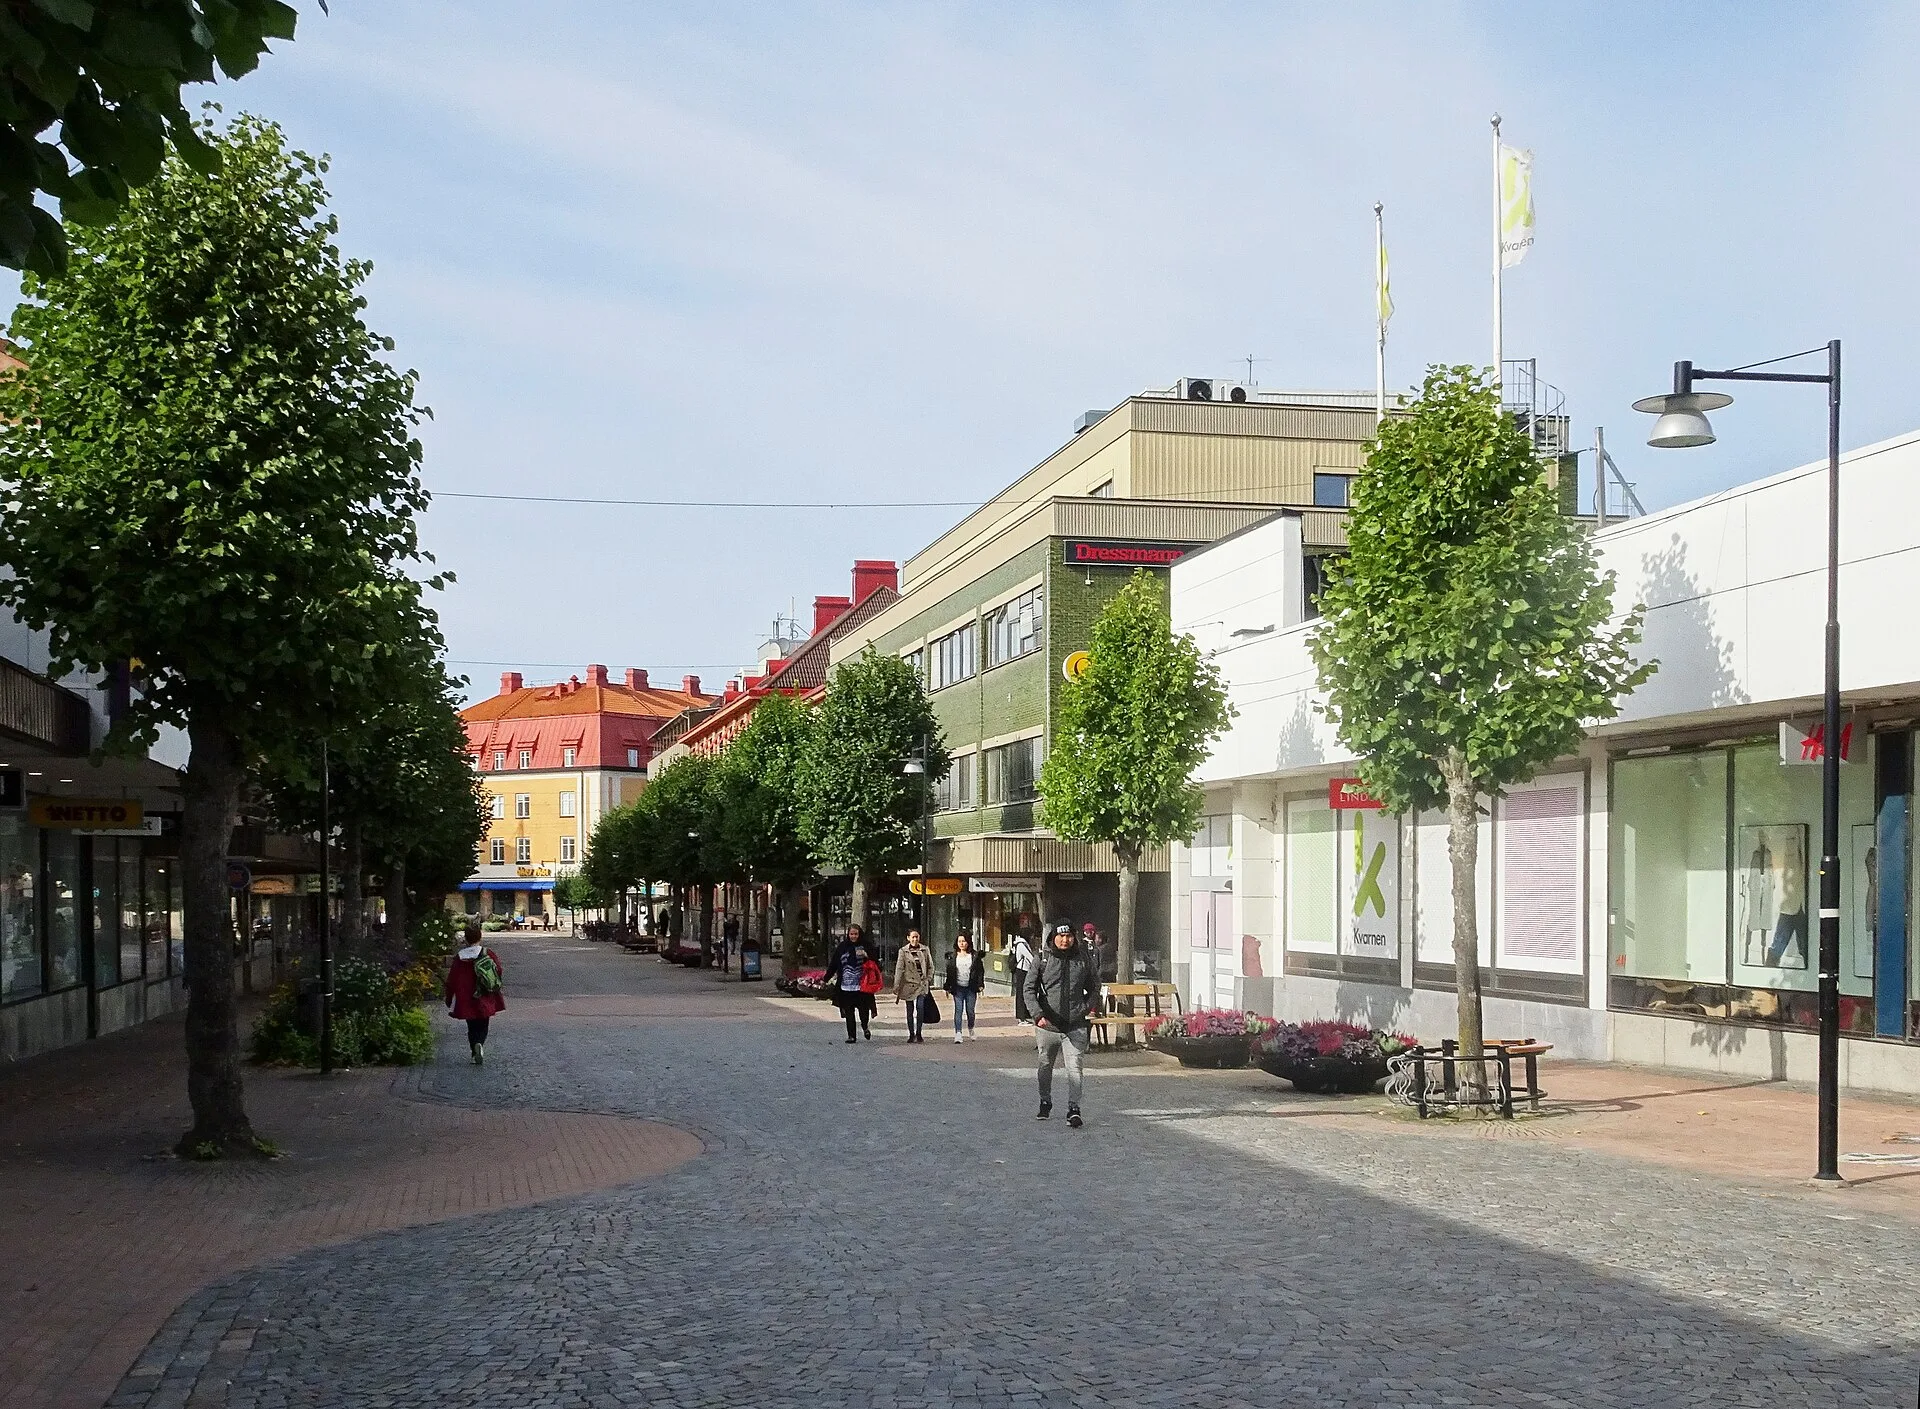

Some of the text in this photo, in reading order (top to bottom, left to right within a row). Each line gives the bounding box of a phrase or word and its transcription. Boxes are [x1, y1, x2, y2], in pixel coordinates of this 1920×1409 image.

[1075, 544, 1185, 564] Dressmann
[1800, 722, 1854, 761] HM
[1340, 790, 1372, 802] LIND
[59, 806, 127, 822] NETTO
[1353, 926, 1387, 947] Kvarnen
